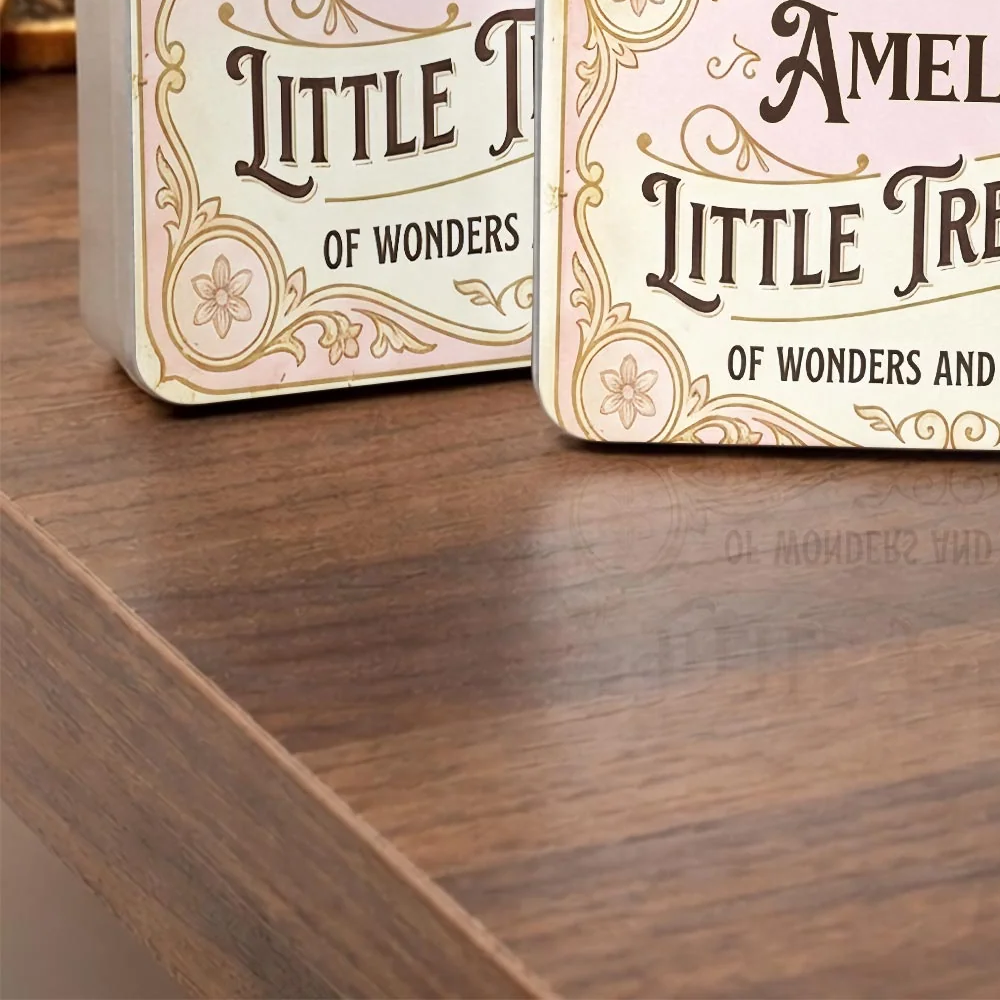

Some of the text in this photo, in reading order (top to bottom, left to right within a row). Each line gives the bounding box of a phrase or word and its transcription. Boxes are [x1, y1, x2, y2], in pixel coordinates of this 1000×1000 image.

[226, 45, 456, 199] LITTLE
[323, 212, 520, 270] OF WONDERS
[641, 172, 862, 314] LITTLE
[727, 344, 765, 382] OF
[777, 346, 922, 387] WONDERS
[933, 350, 996, 388] AND
